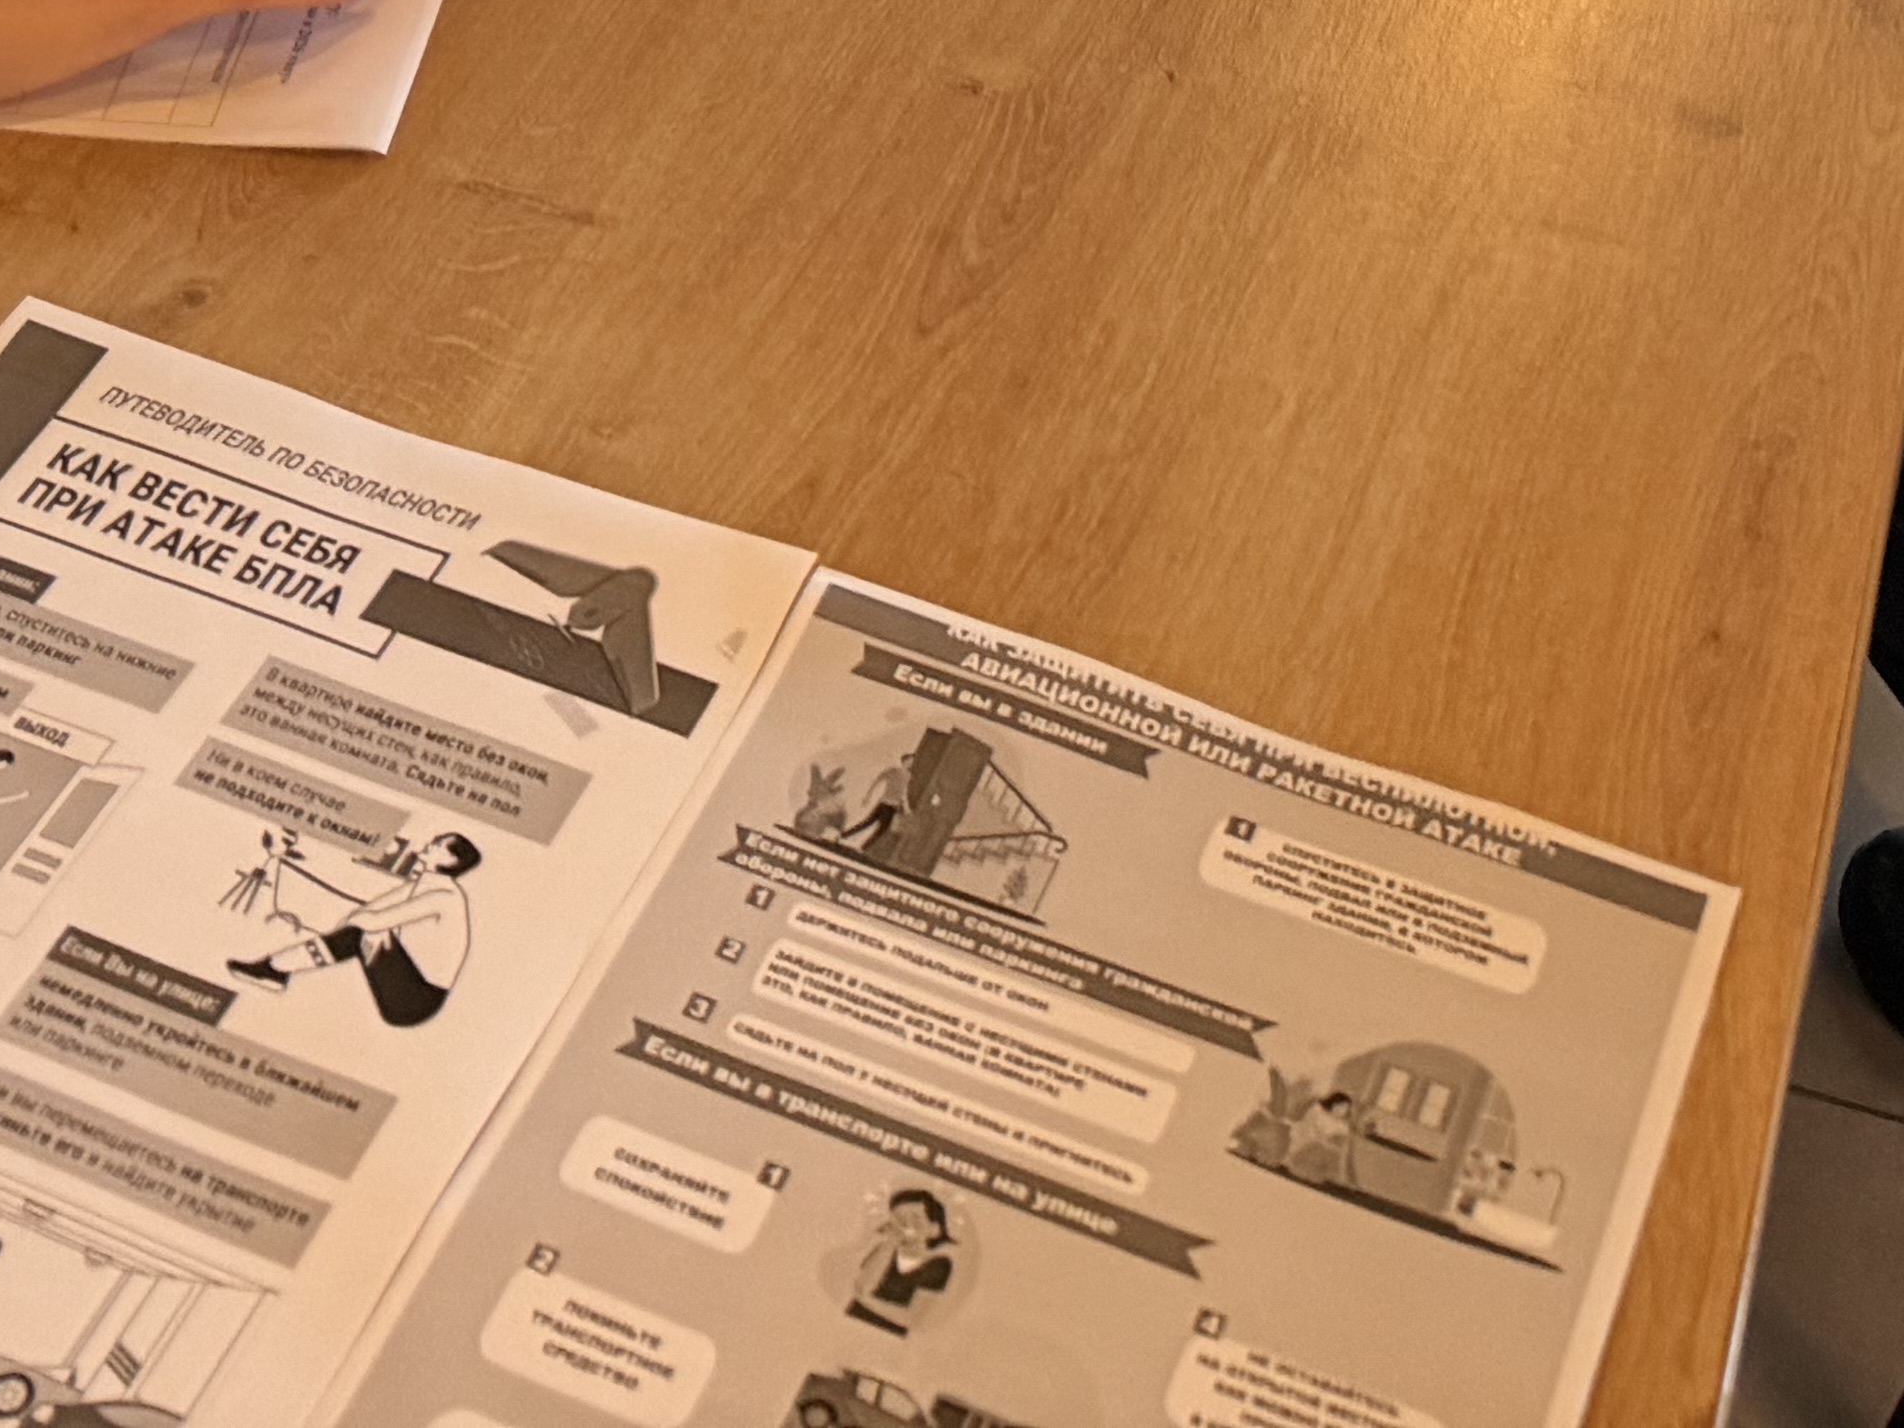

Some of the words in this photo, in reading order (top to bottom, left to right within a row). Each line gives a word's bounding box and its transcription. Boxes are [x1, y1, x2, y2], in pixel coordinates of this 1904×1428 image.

[96, 385, 270, 459] ПУТЕВОДИТЕЛЬ
[265, 444, 308, 472] ПО
[300, 456, 482, 534] БЕЗОПАСНОСТИ
[15, 476, 108, 528] ПРИ
[99, 506, 239, 576] АТАКЕ
[231, 553, 352, 617] БПЛА
[43, 442, 135, 493] КАК
[125, 471, 261, 538] ВЕСТИ
[255, 517, 364, 575] СЕБЯ
[3, 608, 94, 650] спуститесь
[91, 641, 117, 659] на
[113, 649, 179, 682] нижние
[14, 634, 83, 668] паркинг
[12, 715, 72, 747] ВЫХОД
[353, 700, 425, 736] найдите
[423, 726, 477, 755] место
[474, 745, 508, 767] без
[891, 662, 957, 699] Если
[957, 686, 994, 712] вы
[1015, 707, 1110, 754] здании
[191, 768, 216, 786] не
[213, 776, 306, 820] подходите
[204, 749, 233, 769] Ни
[244, 764, 290, 791] коем
[287, 780, 349, 814] случае
[960, 650, 1184, 746] АВИАЦИОННОЙ
[1186, 735, 1252, 773] ИЛИ
[1256, 760, 1418, 832] РАКЕТНОЙ
[1419, 817, 1524, 869] АТАКЕ
[743, 831, 801, 863] Если
[801, 853, 842, 879] нет
[842, 868, 961, 923] защитного
[961, 915, 1100, 976] сооружения
[836, 889, 928, 933] подвала
[930, 924, 976, 951] или
[977, 942, 1085, 991] паркинга
[56, 935, 106, 967] Если
[101, 953, 138, 979] Вы
[131, 965, 163, 989] на
[35, 975, 147, 1028] немедленно
[144, 1017, 239, 1065] укройтесь
[252, 1060, 362, 1114] ближайшем
[642, 1035, 711, 1076] Если
[712, 1062, 754, 1093] вы
[775, 1087, 931, 1162] транспорте
[931, 1147, 989, 1185] или
[991, 1171, 1030, 1201] на
[1032, 1187, 1119, 1237] улице
